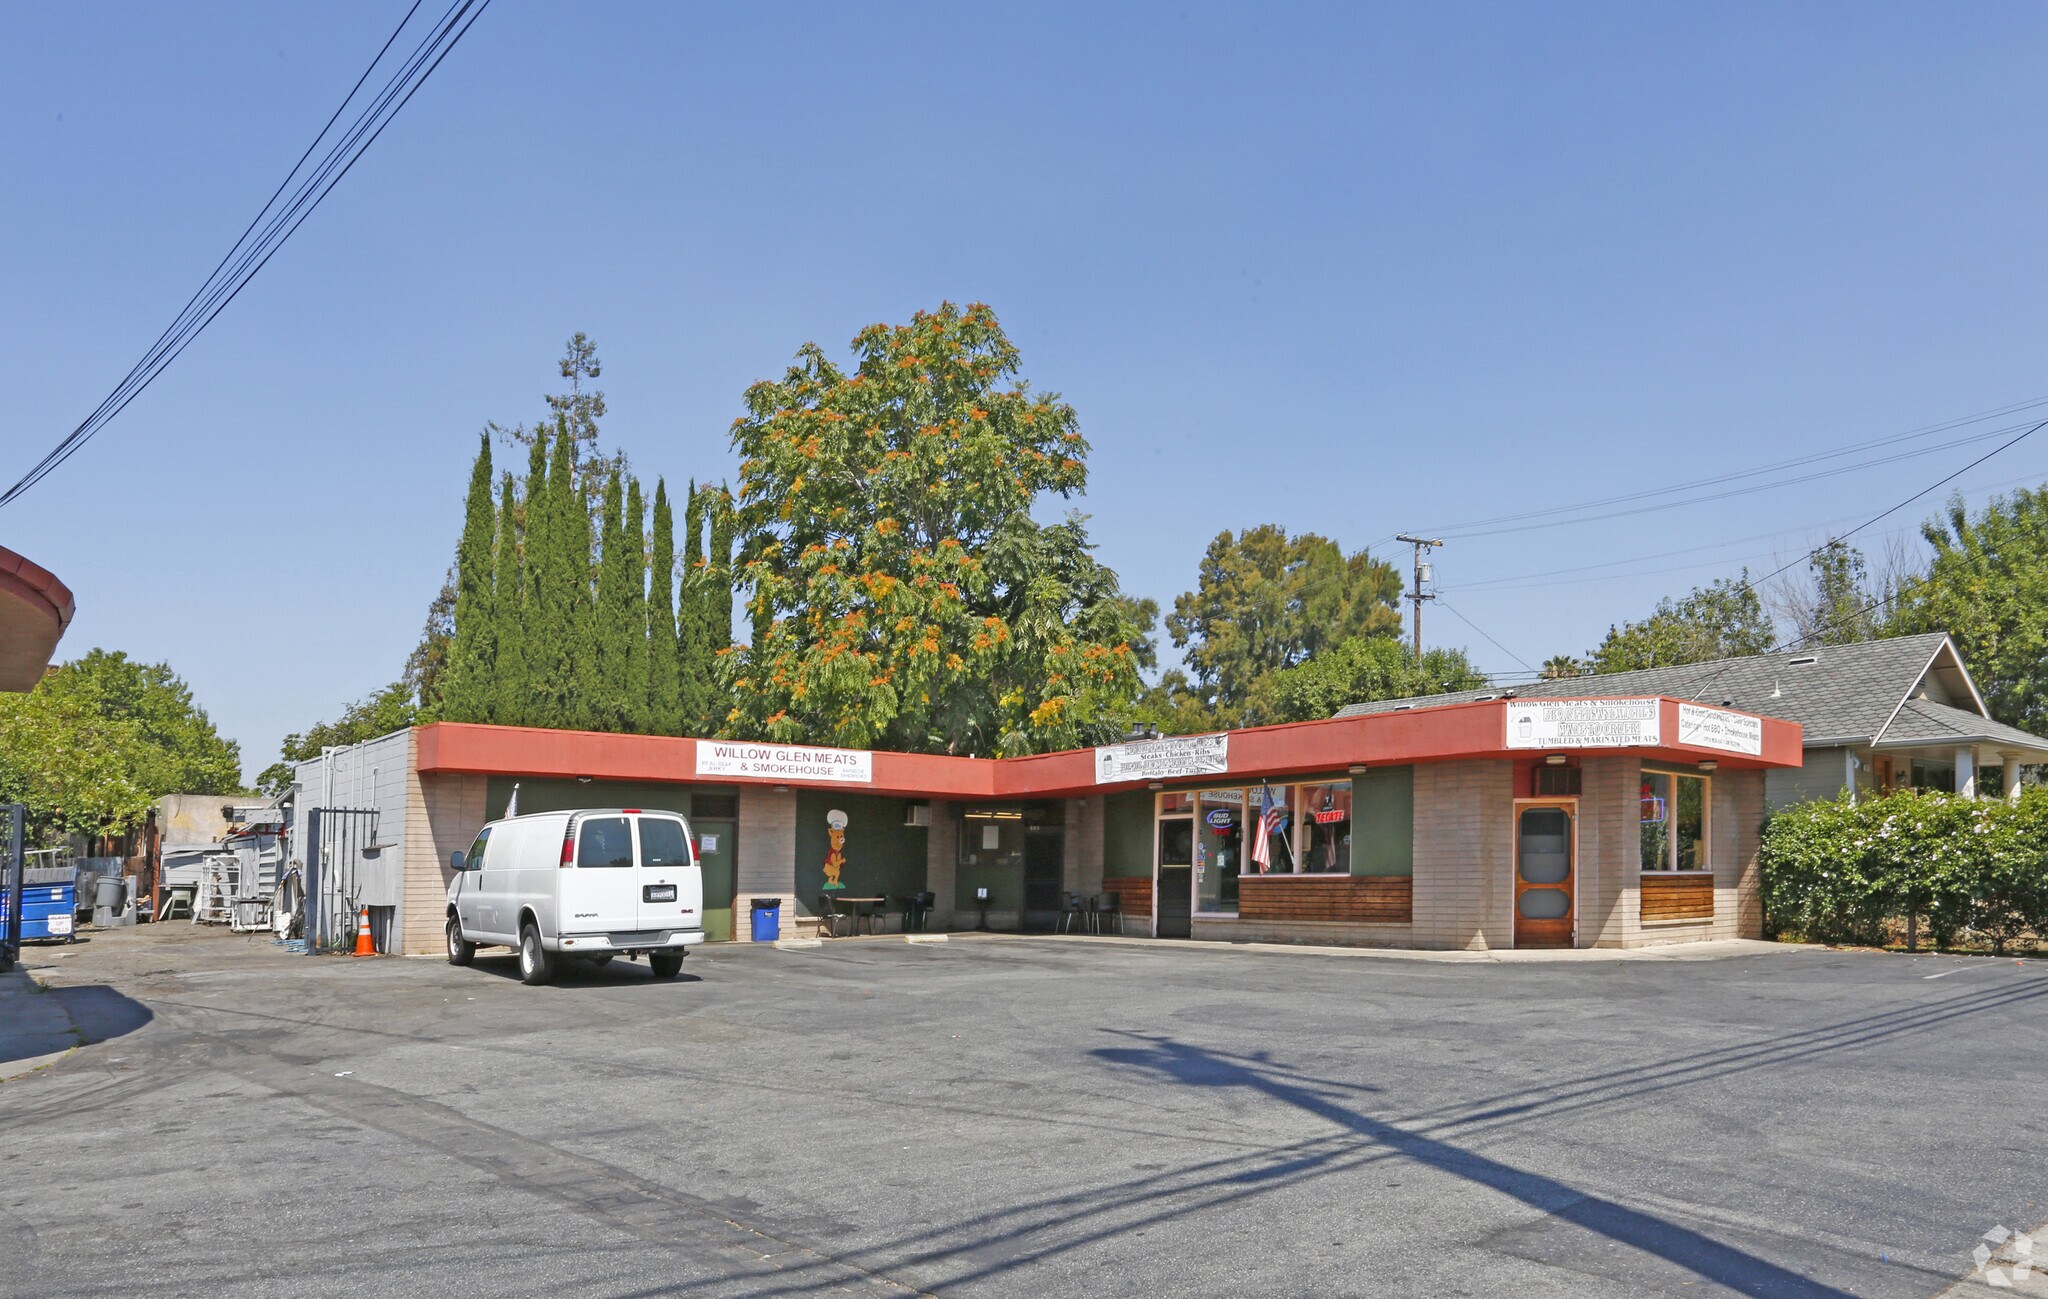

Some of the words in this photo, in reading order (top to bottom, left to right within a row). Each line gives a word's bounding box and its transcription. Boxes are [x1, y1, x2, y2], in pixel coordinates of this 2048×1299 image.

[1589, 706, 1656, 721] SANDWICHES
[1558, 722, 1588, 737] MADE
[1538, 737, 1574, 745] TUMBLED
[1584, 736, 1630, 744] MARINATED
[1632, 735, 1658, 743] MEATS
[714, 747, 771, 760] WILLOW
[776, 750, 811, 763] GLEN
[814, 752, 857, 765] MEATS
[740, 763, 748, 771] &
[753, 763, 834, 776] SMOKEHOUSE
[1316, 810, 1343, 823] TECATE
